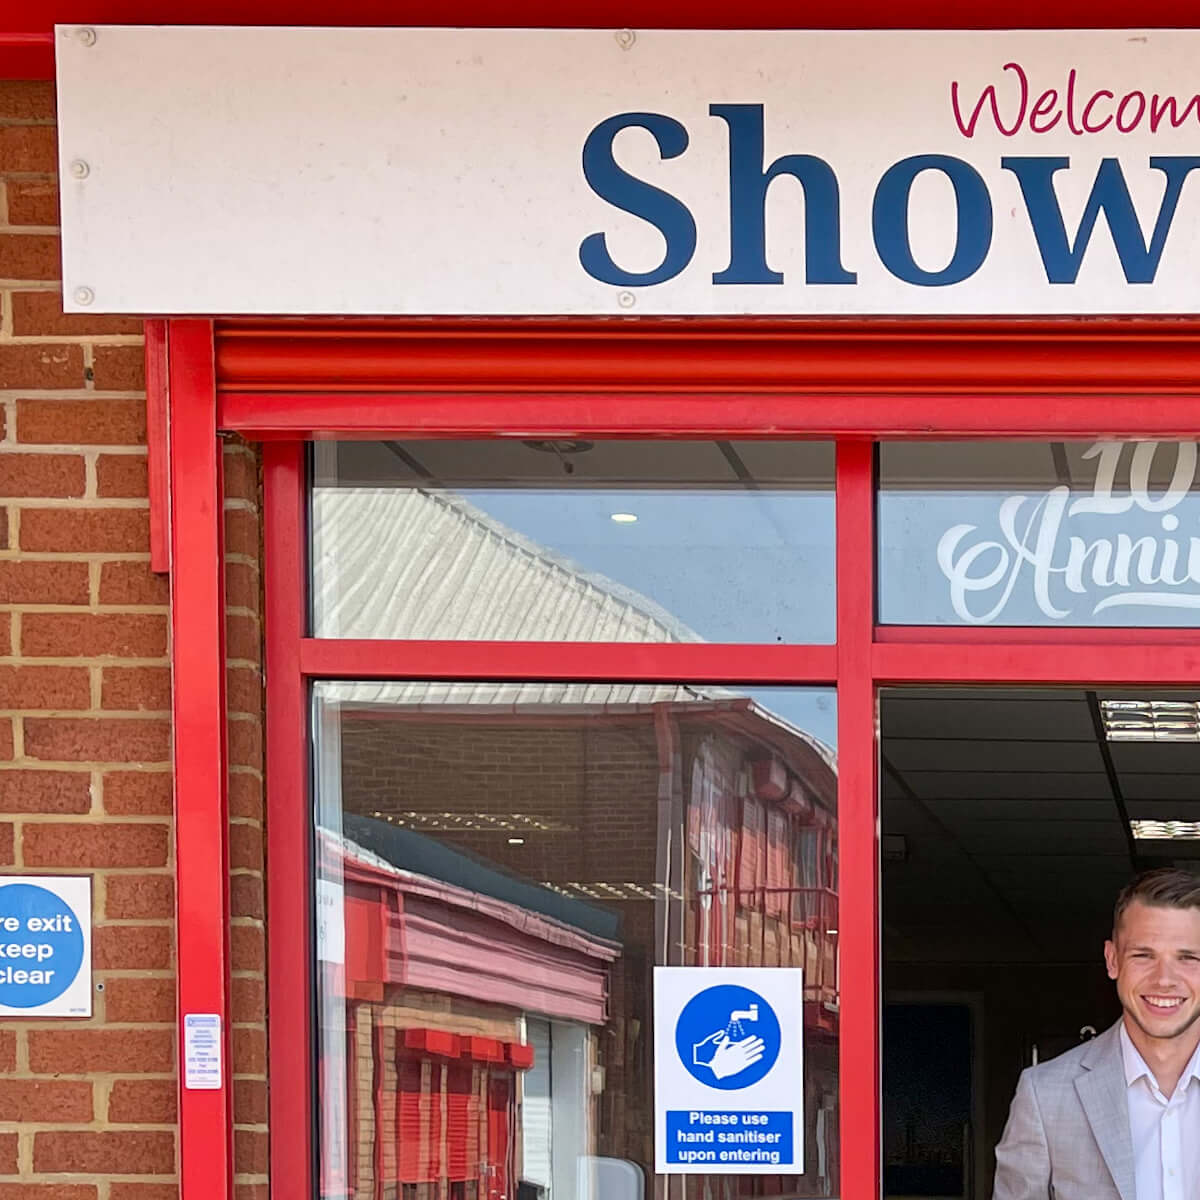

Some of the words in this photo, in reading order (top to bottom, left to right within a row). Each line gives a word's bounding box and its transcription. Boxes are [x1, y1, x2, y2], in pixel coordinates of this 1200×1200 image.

[1068, 440, 1199, 518] 10
[27, 914, 73, 932] exit
[689, 1112, 738, 1125] Please
[742, 1115, 769, 1125] use
[677, 1130, 715, 1143] hand
[717, 1131, 782, 1143] sanitiser
[678, 1151, 716, 1163] upon
[719, 1149, 781, 1164] entering
